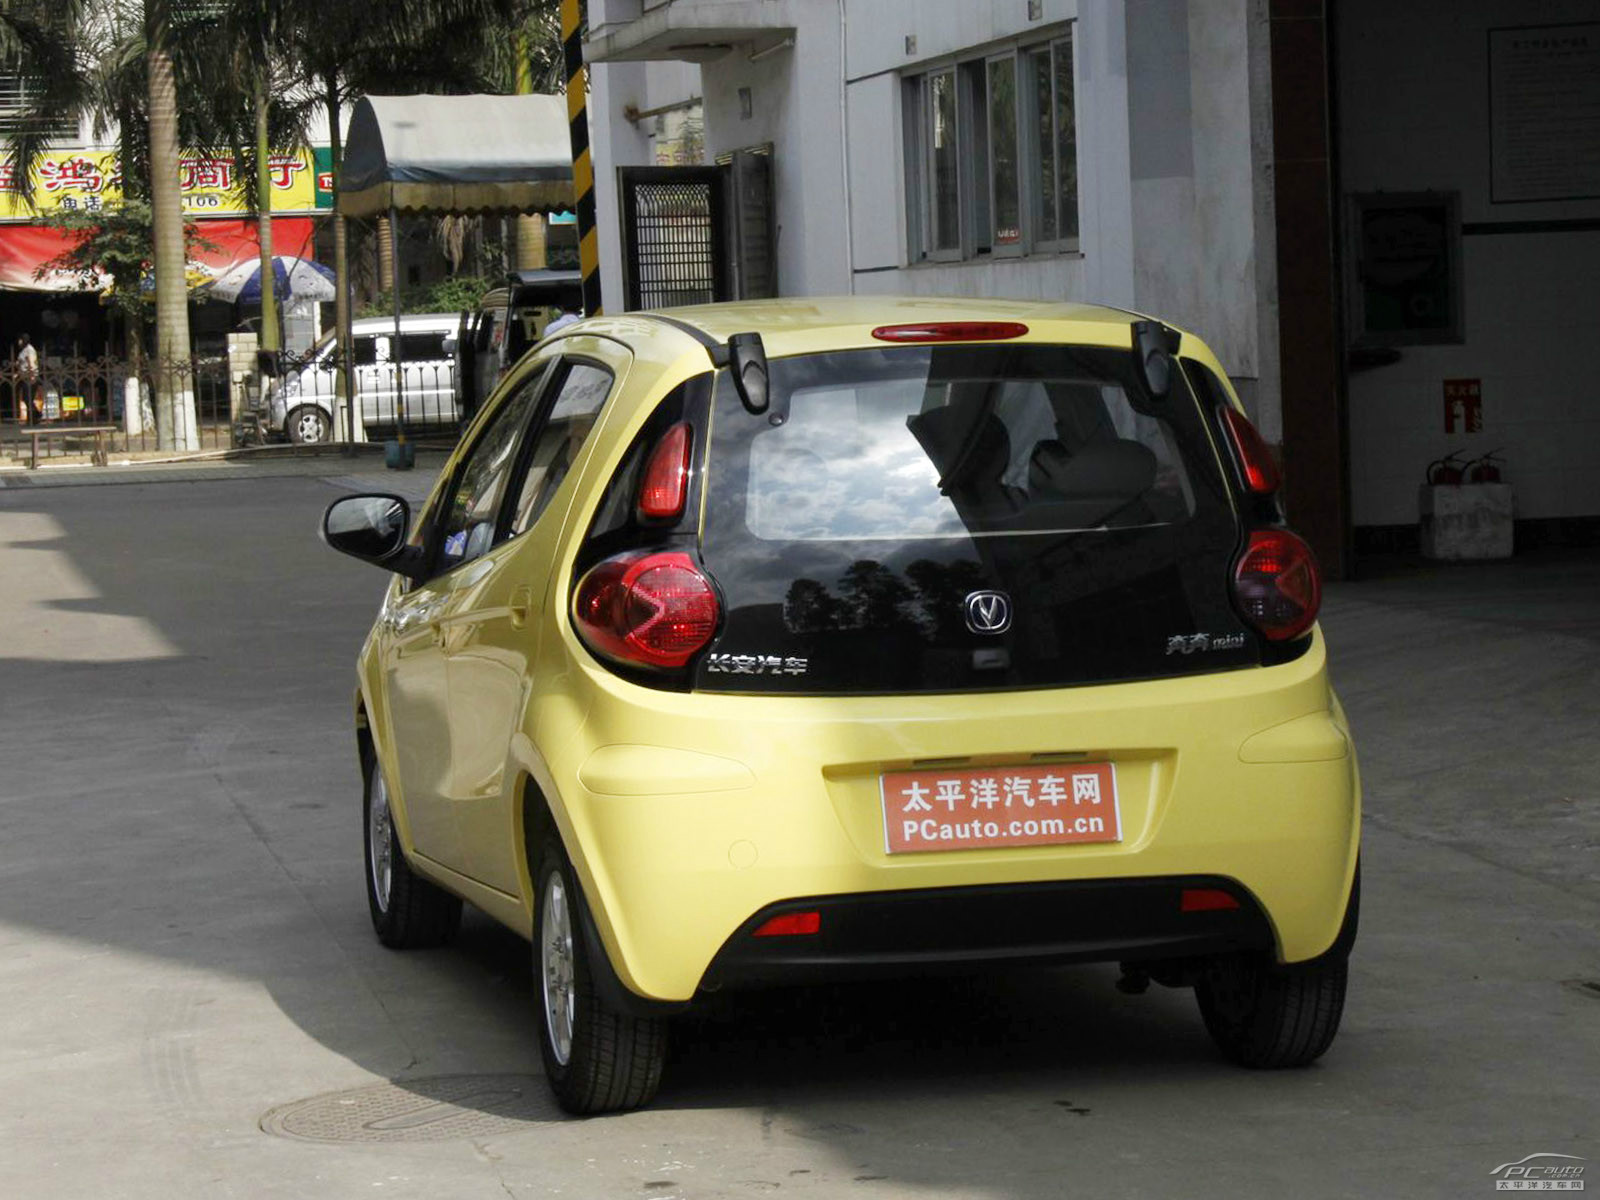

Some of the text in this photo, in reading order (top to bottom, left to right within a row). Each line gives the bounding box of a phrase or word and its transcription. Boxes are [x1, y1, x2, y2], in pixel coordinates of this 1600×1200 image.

[707, 653, 808, 675] 长安汽车
[901, 773, 1102, 812] 太平洋汽车网
[903, 816, 1104, 841] PCauto.com.cn
